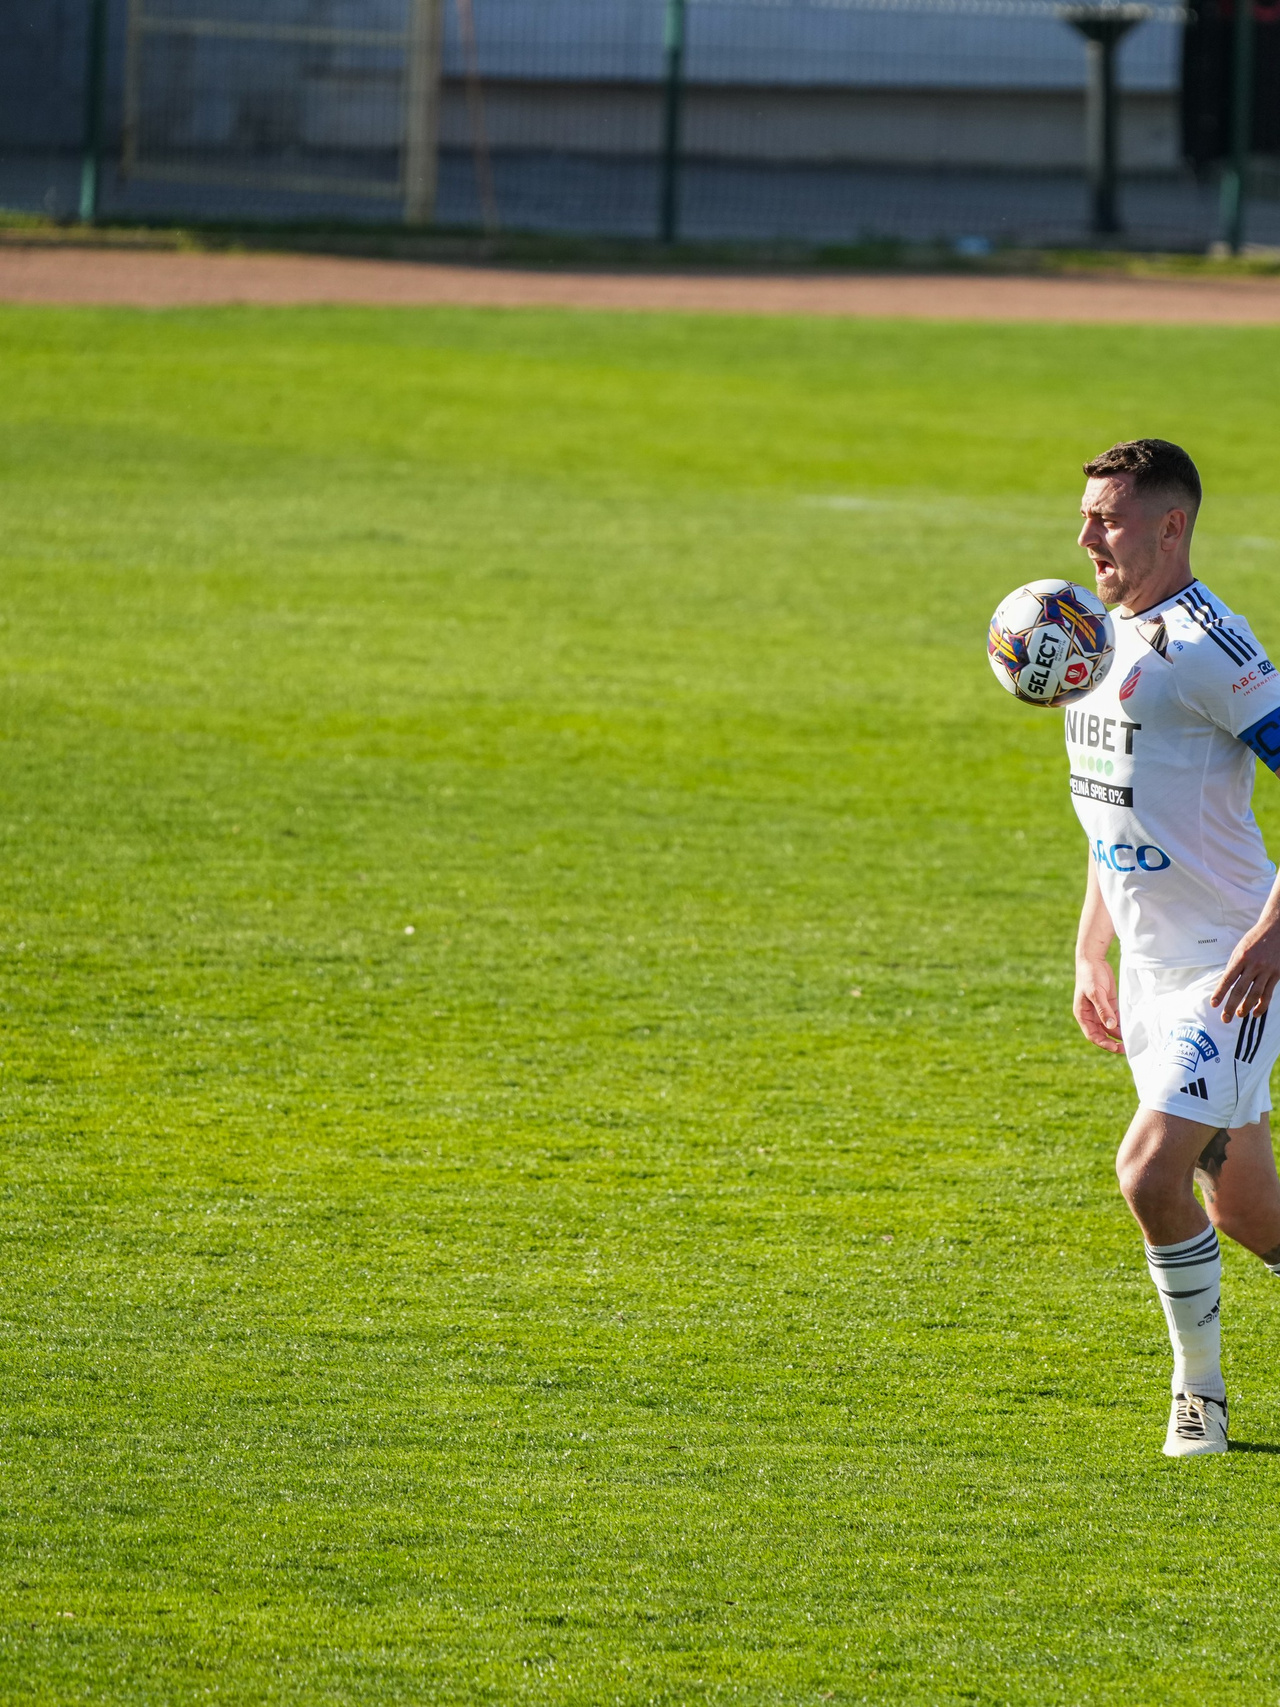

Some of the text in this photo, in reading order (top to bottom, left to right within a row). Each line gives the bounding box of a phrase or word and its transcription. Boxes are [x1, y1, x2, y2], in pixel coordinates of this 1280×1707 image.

[1028, 632, 1060, 695] SELECT
[1090, 783, 1108, 802] SPRE
[1108, 788, 1125, 805] 0%
[1176, 1027, 1215, 1058] ONTINENTS
